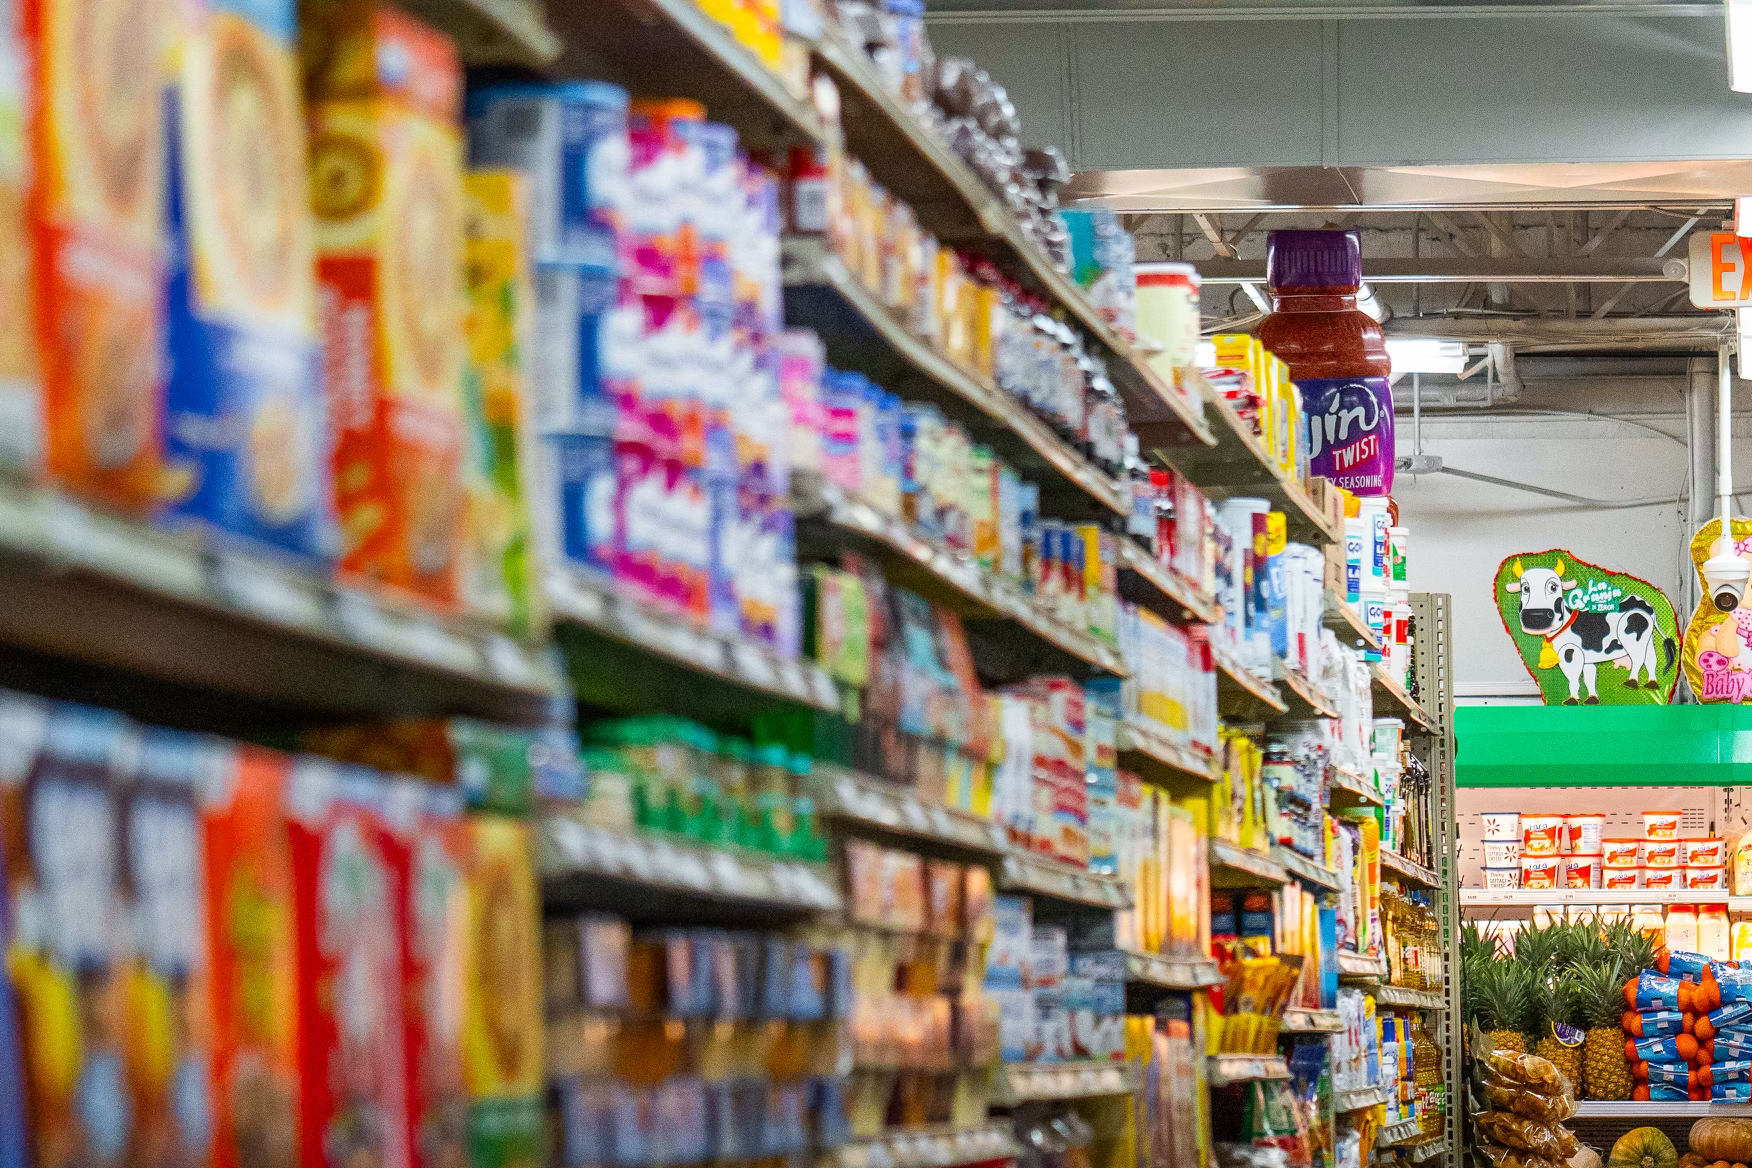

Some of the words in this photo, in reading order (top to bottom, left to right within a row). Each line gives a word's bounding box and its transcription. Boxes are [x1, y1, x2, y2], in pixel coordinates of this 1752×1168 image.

[1333, 434, 1377, 471] TWIST
[1339, 475, 1382, 489] SEASONING
[1703, 670, 1745, 701] Baby
